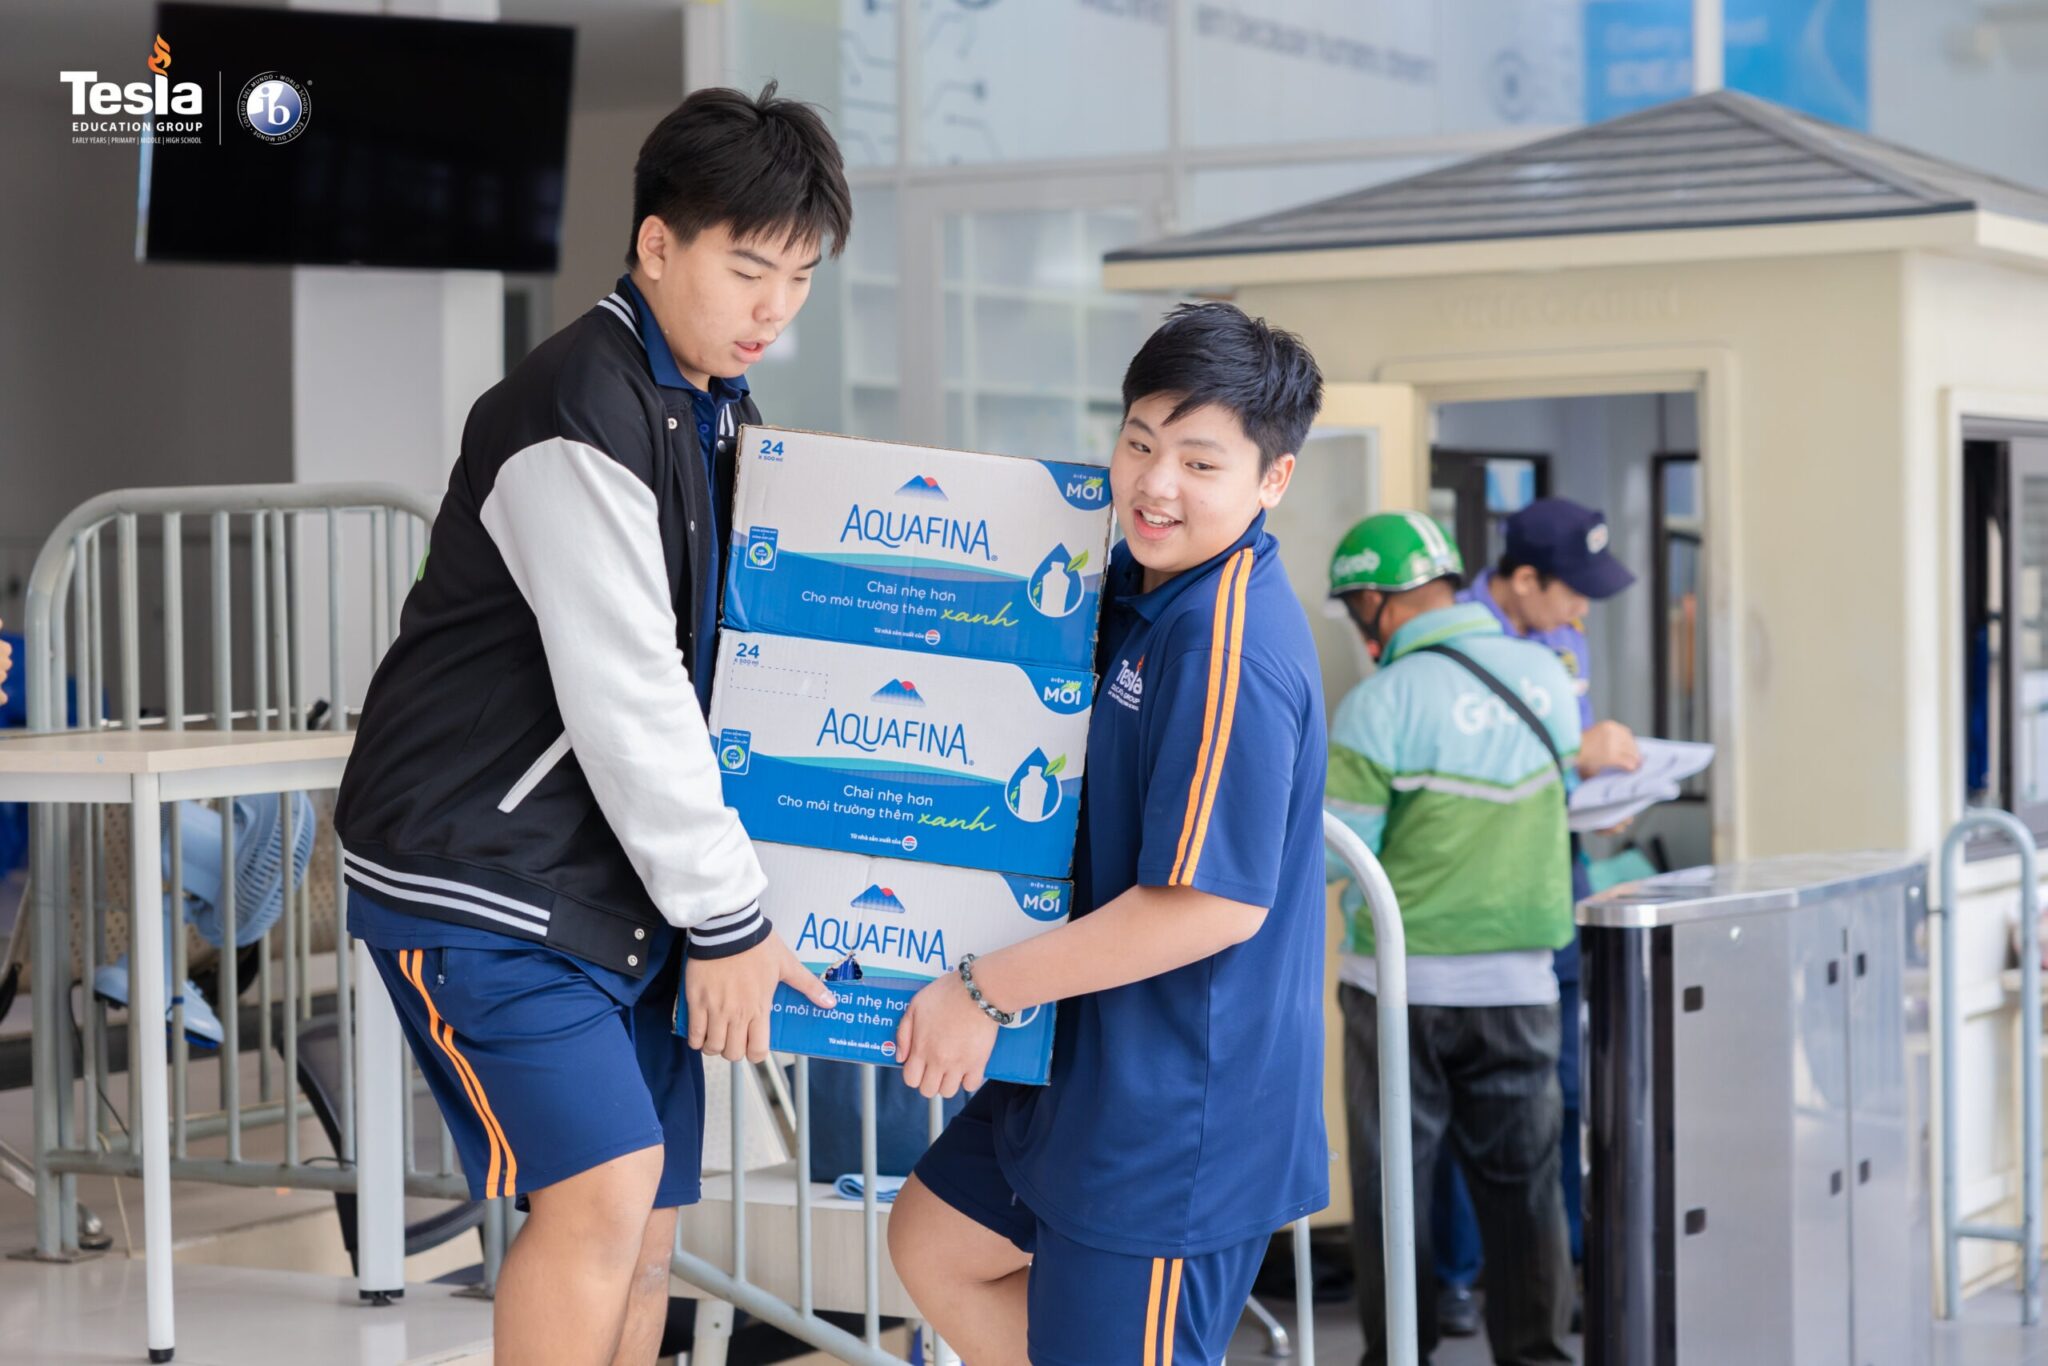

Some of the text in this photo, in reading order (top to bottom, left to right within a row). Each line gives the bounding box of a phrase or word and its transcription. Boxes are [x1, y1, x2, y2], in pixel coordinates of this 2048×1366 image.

[760, 439, 784, 456] 24
[840, 504, 990, 561] AQUAFINA
[867, 580, 957, 603] Chai nhẹ hơn
[801, 590, 1019, 627] Cho môi trường thêm xanh
[736, 642, 760, 659] 24
[1116, 659, 1143, 695] Tesla
[816, 707, 968, 765] AQUAFINA
[843, 784, 933, 807] Chai nhẹ hơn
[777, 794, 997, 832] Cho môi trường thêm xanh
[796, 912, 947, 970] AQUAFINA
[830, 989, 853, 1005] hai
[857, 994, 882, 1010] nhẹ
[785, 1003, 809, 1016] môi
[812, 1007, 855, 1024] trường
[858, 1012, 893, 1027] thêm
